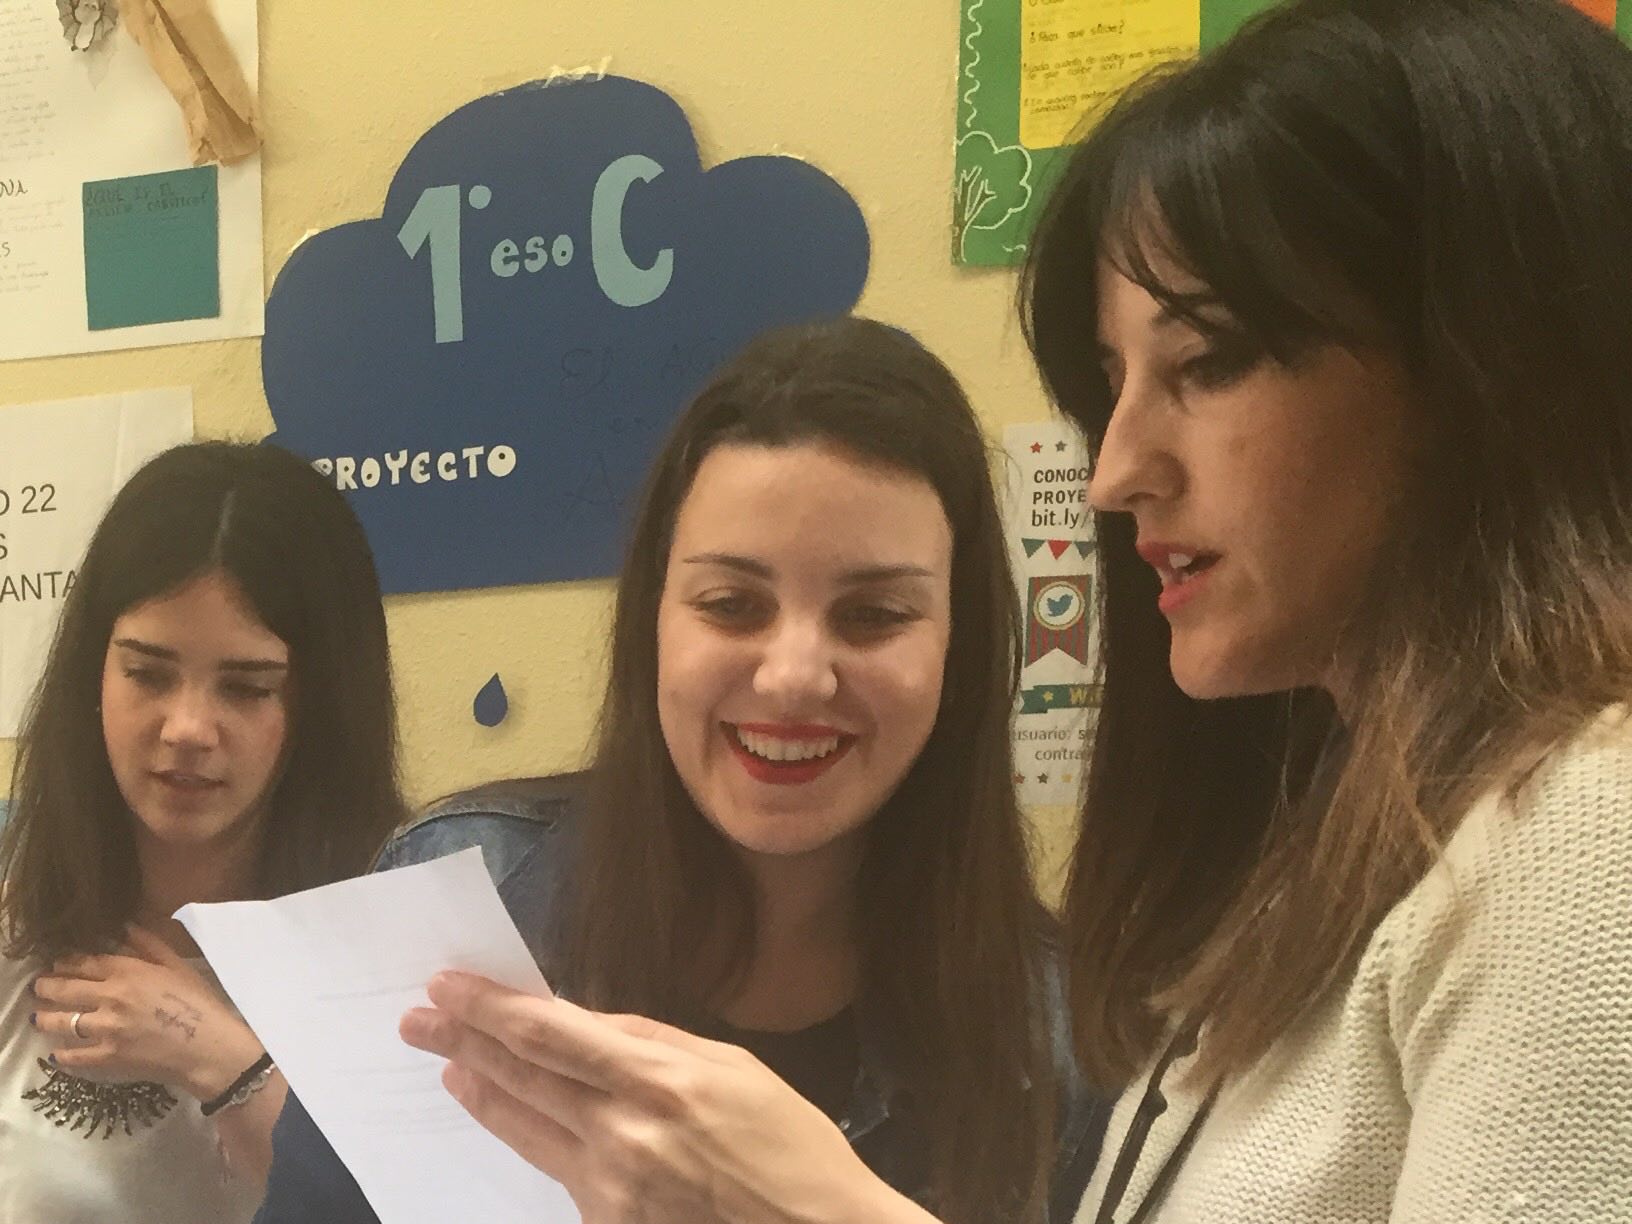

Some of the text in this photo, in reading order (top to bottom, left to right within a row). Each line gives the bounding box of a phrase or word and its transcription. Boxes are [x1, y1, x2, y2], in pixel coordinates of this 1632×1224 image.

[490, 234, 574, 277] eso
[591, 154, 674, 307] C
[311, 445, 517, 491] PROYECTO
[1033, 467, 1089, 484] CONOC
[21, 483, 58, 514] 22
[1032, 488, 1087, 504] PROYE
